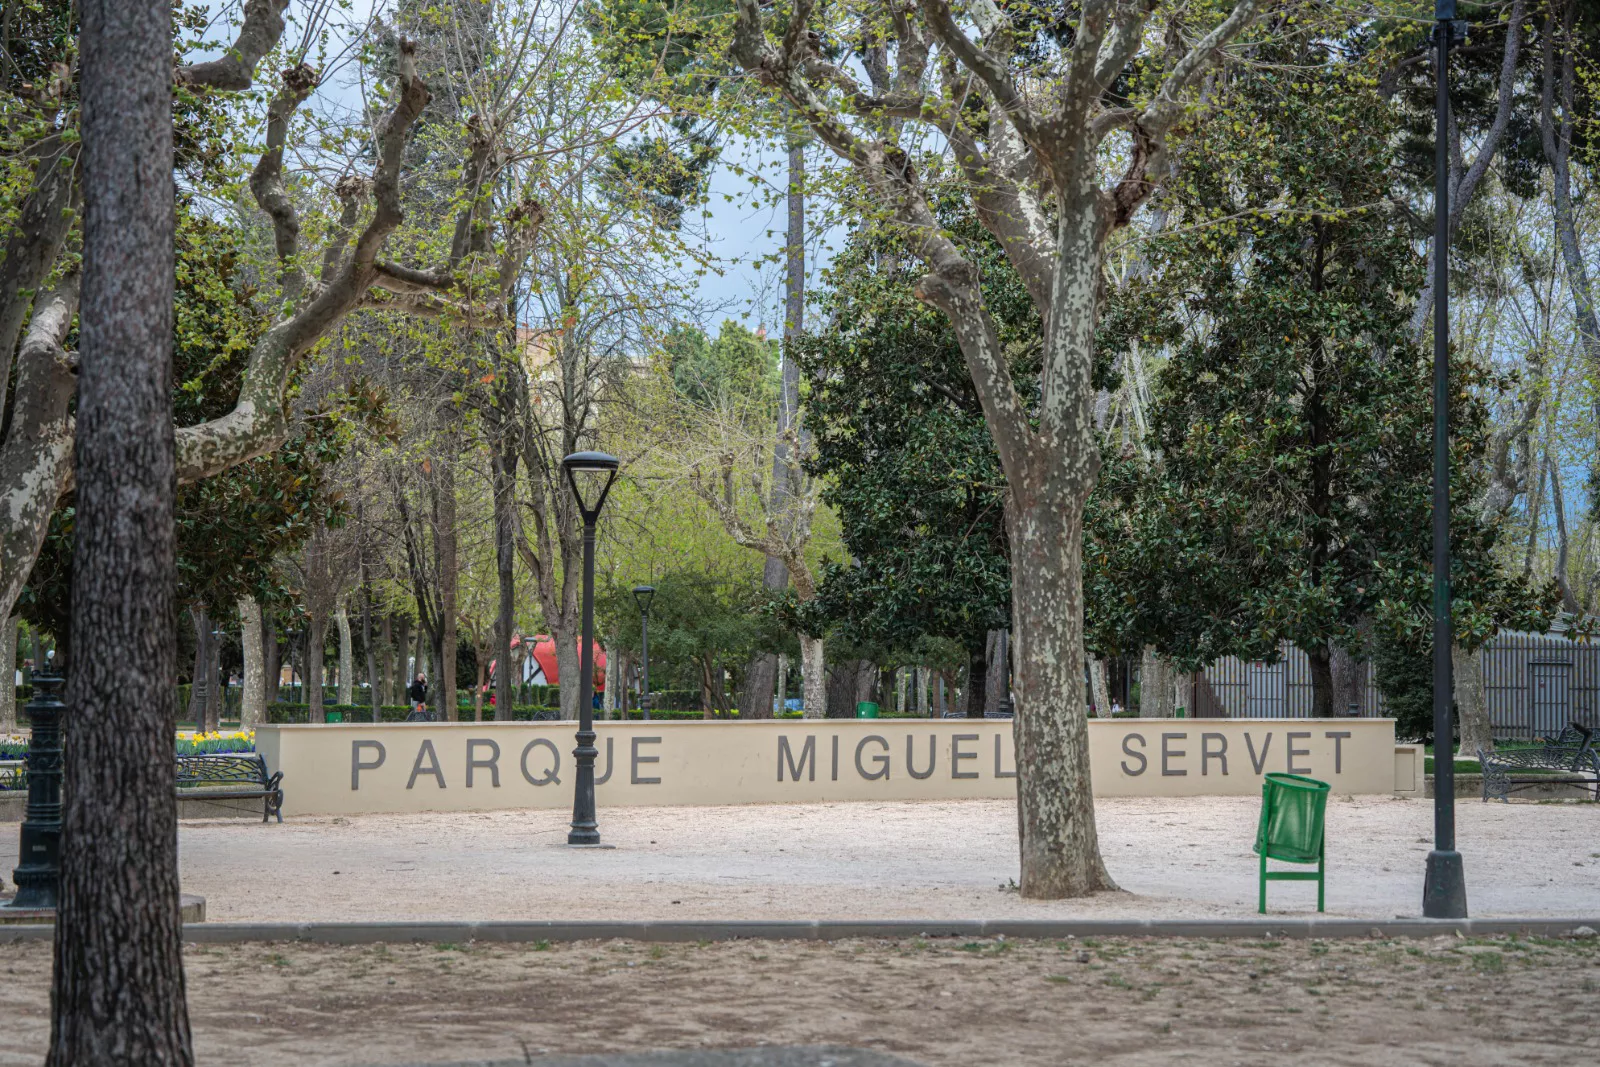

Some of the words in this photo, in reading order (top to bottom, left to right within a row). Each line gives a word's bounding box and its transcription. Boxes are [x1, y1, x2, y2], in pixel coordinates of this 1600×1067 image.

[351, 735, 663, 791] PARQUE
[776, 733, 1017, 783] MIGUEL
[1120, 731, 1353, 778] SERVET
